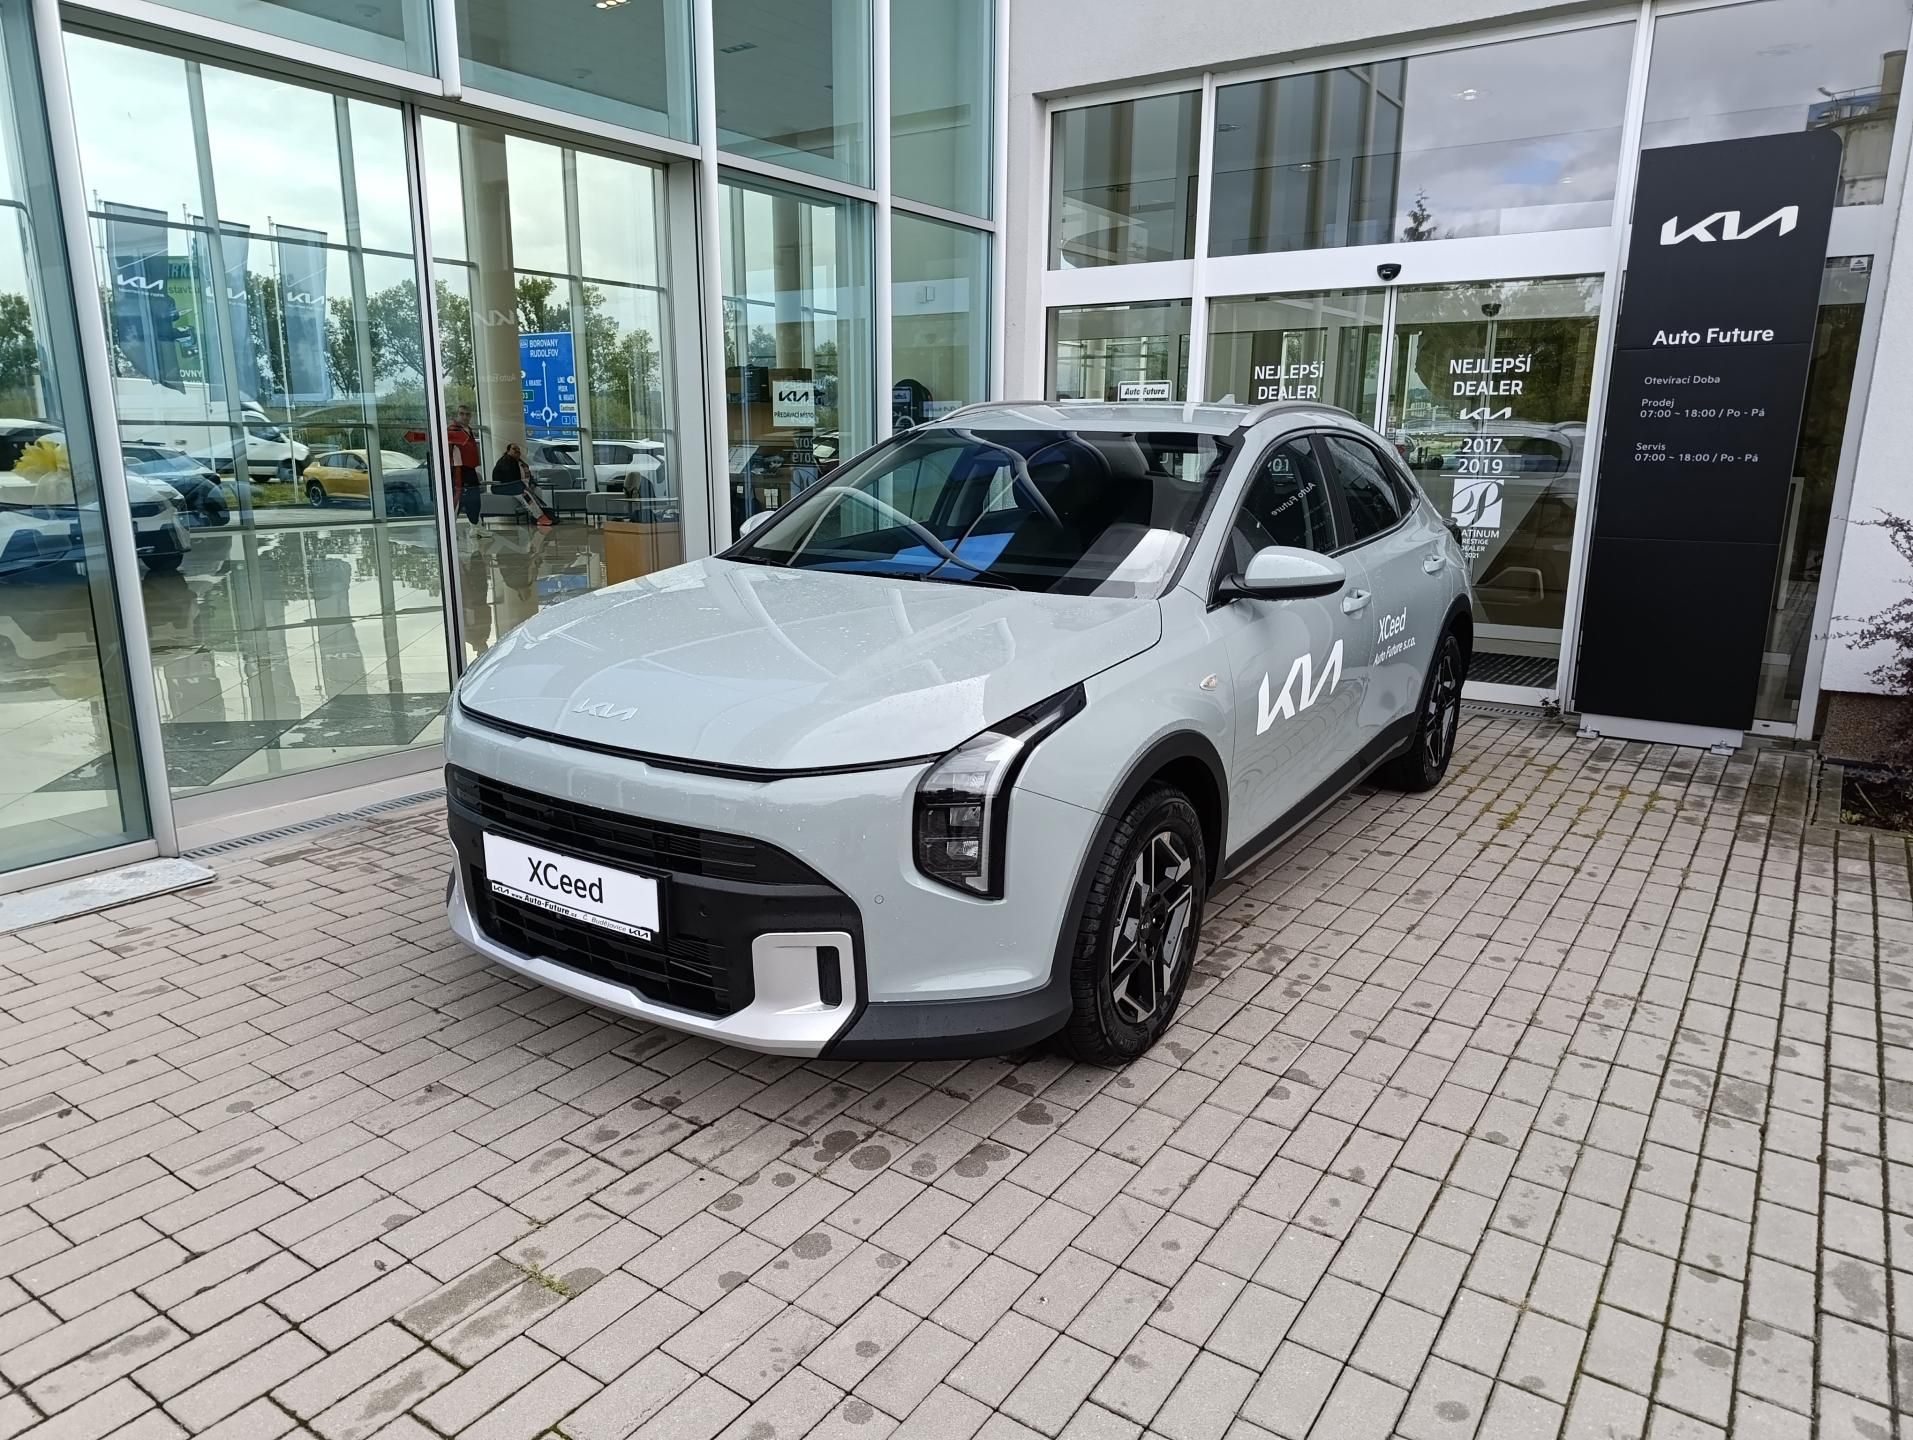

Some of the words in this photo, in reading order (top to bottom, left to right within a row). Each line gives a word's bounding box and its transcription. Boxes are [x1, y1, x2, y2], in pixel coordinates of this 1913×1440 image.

[1660, 205, 1799, 246] KIA
[117, 274, 164, 290] KIA
[287, 291, 325, 304] KIA
[529, 339, 559, 347] BOROVANY
[1652, 330, 1701, 345] Auto
[1706, 327, 1775, 344] Future
[530, 349, 559, 357] RUDOLFOV
[1254, 360, 1325, 380] NEJLEPŠÍ
[1449, 354, 1532, 374] NEJLEPŠÍ
[1644, 375, 1692, 385] Otevírací
[1693, 375, 1721, 384] Doba
[1125, 388, 1140, 396] Auto
[1258, 385, 1317, 400] DEALER
[1453, 380, 1523, 396] DEALER
[778, 391, 809, 402] KIA
[1641, 398, 1675, 408] Prodej
[1459, 407, 1512, 420] KIA
[1640, 409, 1672, 418] 07:00
[1684, 409, 1716, 418] 18:00
[1726, 408, 1741, 417] Po
[1751, 408, 1765, 417] Pá
[1462, 438, 1503, 453] 2017
[1635, 442, 1666, 451] Servis
[1634, 453, 1666, 462] 07:00
[1679, 453, 1710, 462] 18:00
[1720, 453, 1734, 462] Po
[1744, 453, 1758, 462] Pá
[1457, 459, 1503, 474] 2019
[1461, 529, 1500, 538] ATINUM
[1377, 606, 1407, 645] XCeed
[1372, 651, 1386, 668] Auto
[1386, 643, 1403, 661] Future
[1256, 639, 1344, 736] KIA
[571, 697, 639, 721] KIA
[527, 857, 604, 904] XCeed
[493, 884, 510, 895] KIA
[629, 928, 649, 938] KIA
